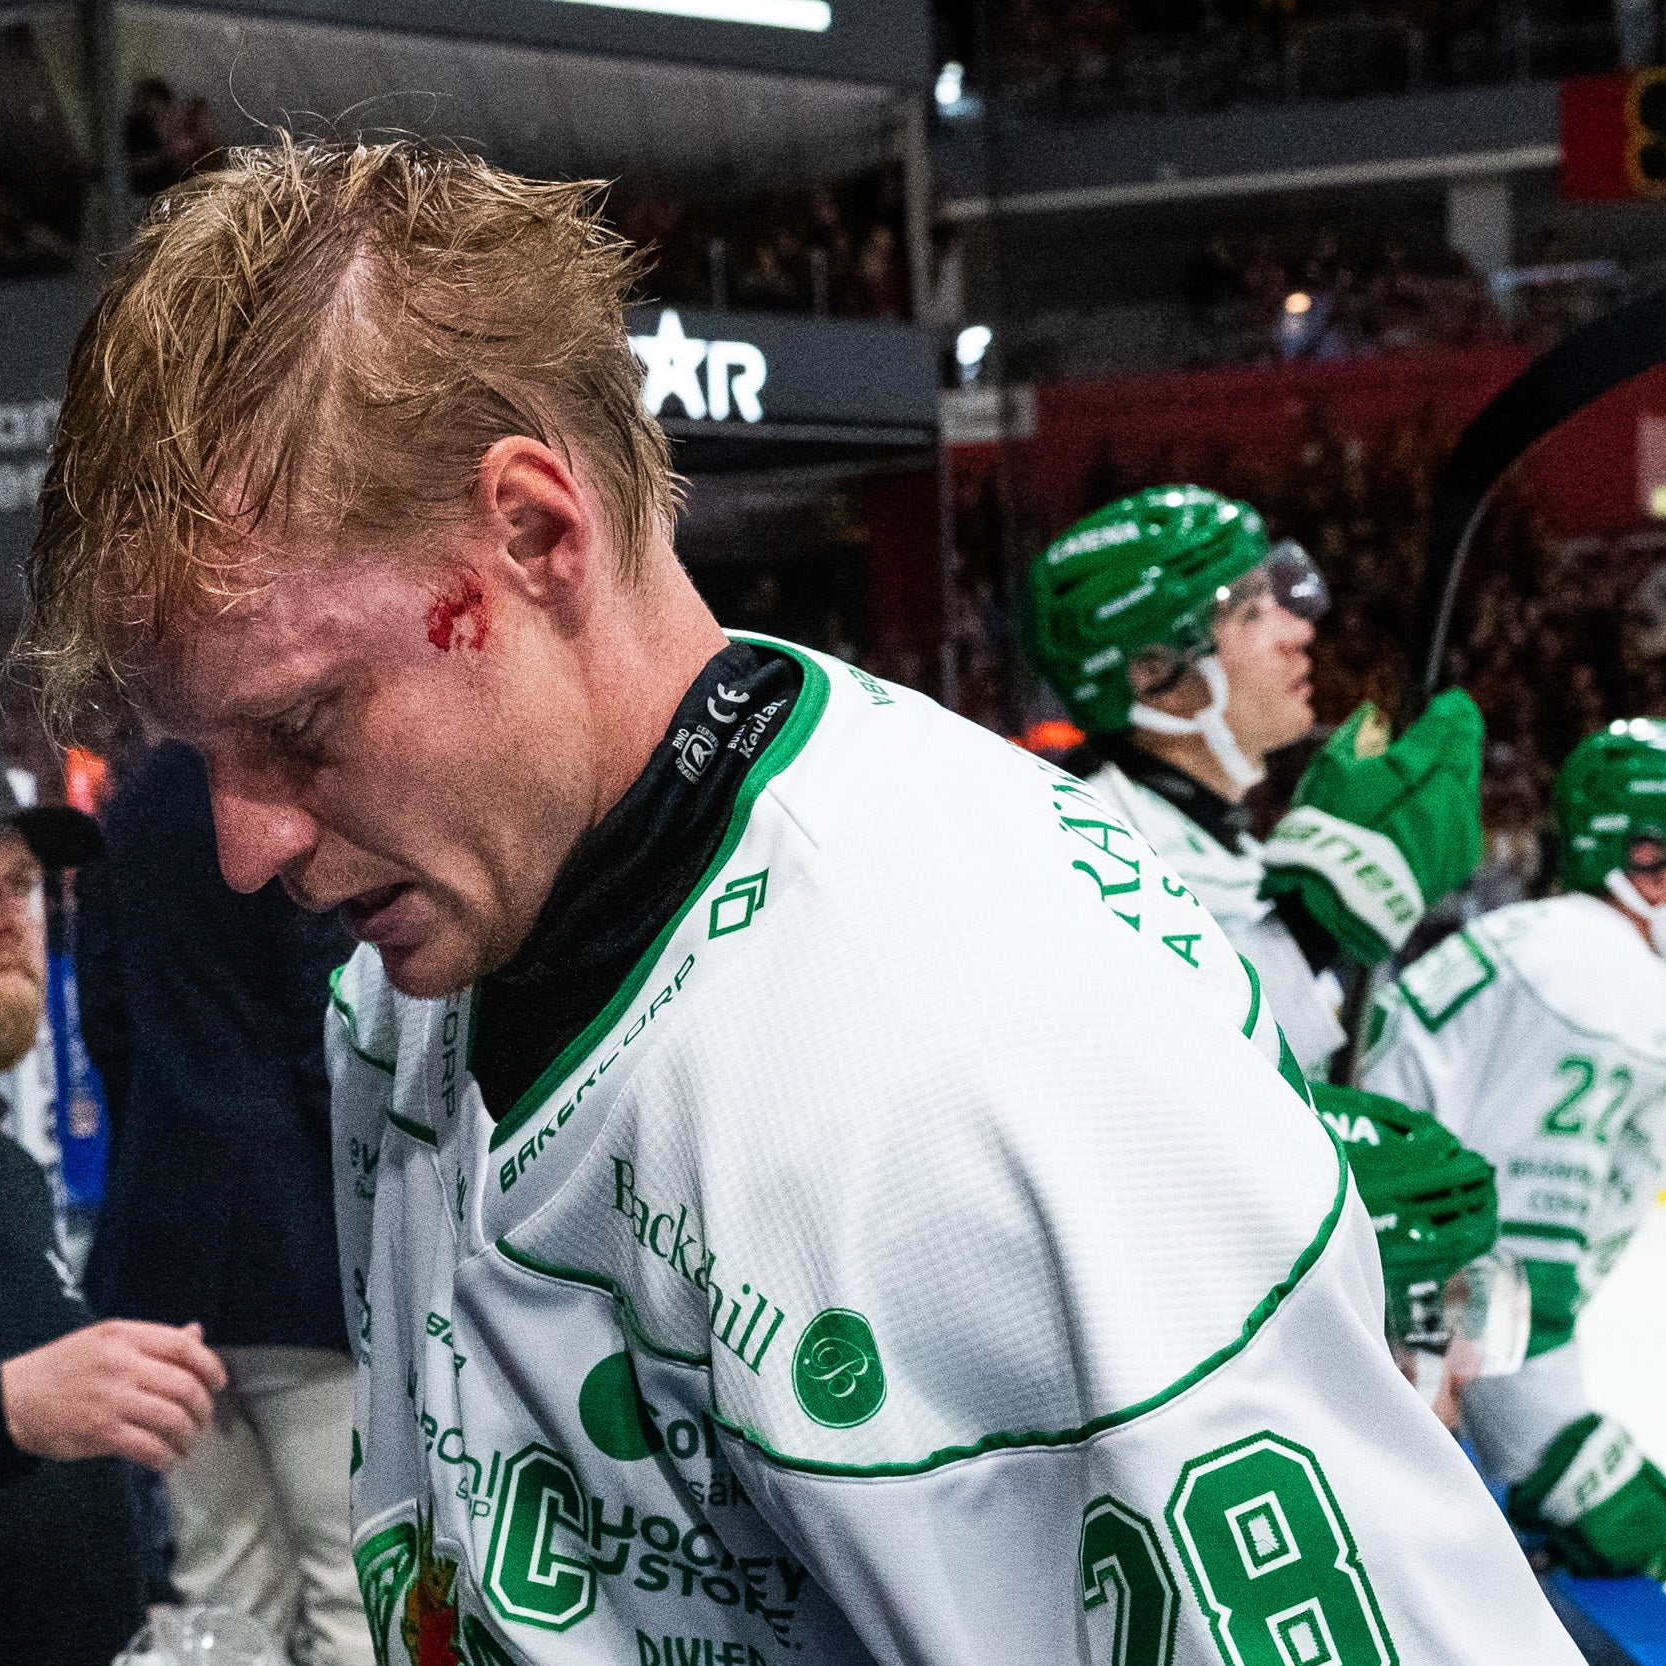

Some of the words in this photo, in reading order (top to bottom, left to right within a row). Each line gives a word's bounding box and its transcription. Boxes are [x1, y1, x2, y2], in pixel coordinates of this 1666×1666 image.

[707, 682, 751, 724] CE
[499, 952, 696, 1195] BAKERCORP
[480, 1441, 599, 1634] C
